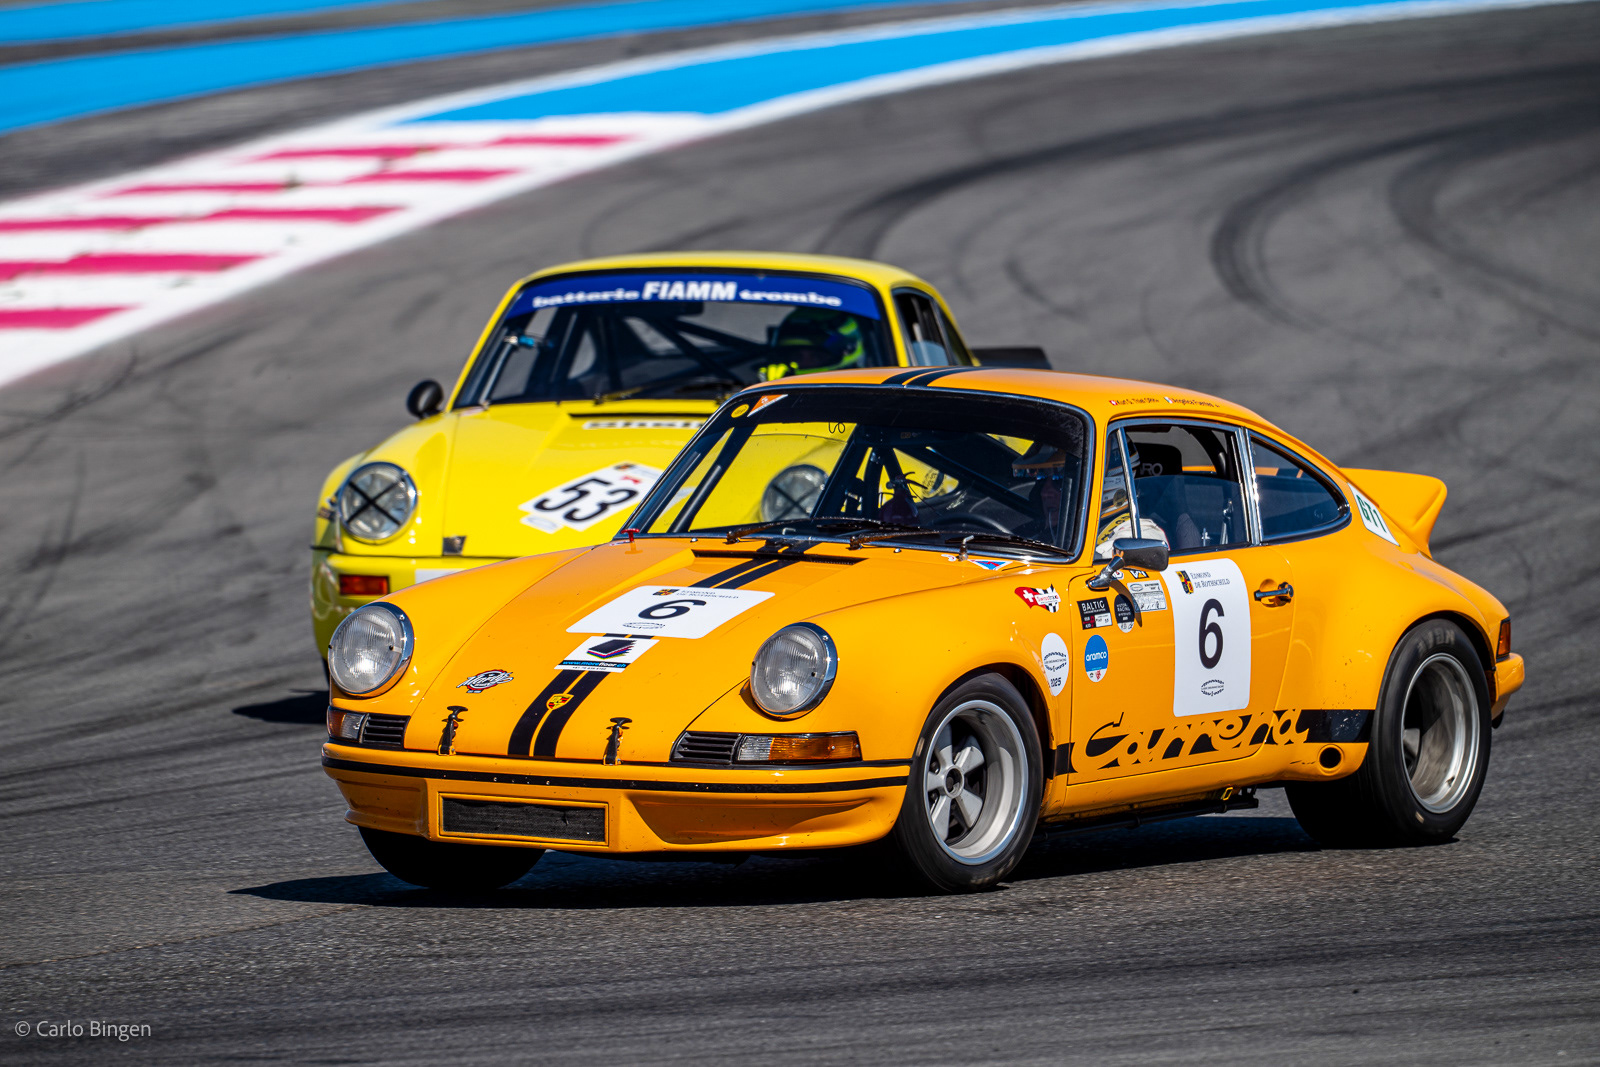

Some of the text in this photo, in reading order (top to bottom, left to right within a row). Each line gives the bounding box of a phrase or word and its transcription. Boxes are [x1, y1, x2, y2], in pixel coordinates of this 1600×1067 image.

[532, 281, 843, 308] batterie FIAMM trombe
[533, 476, 640, 522] 53
[1356, 494, 1387, 533] GT1
[637, 599, 707, 620] 6
[1081, 600, 1105, 612] BALTIC
[1198, 598, 1225, 669] 6
[1085, 651, 1108, 662] aramco
[1071, 708, 1310, 772] Carrera
